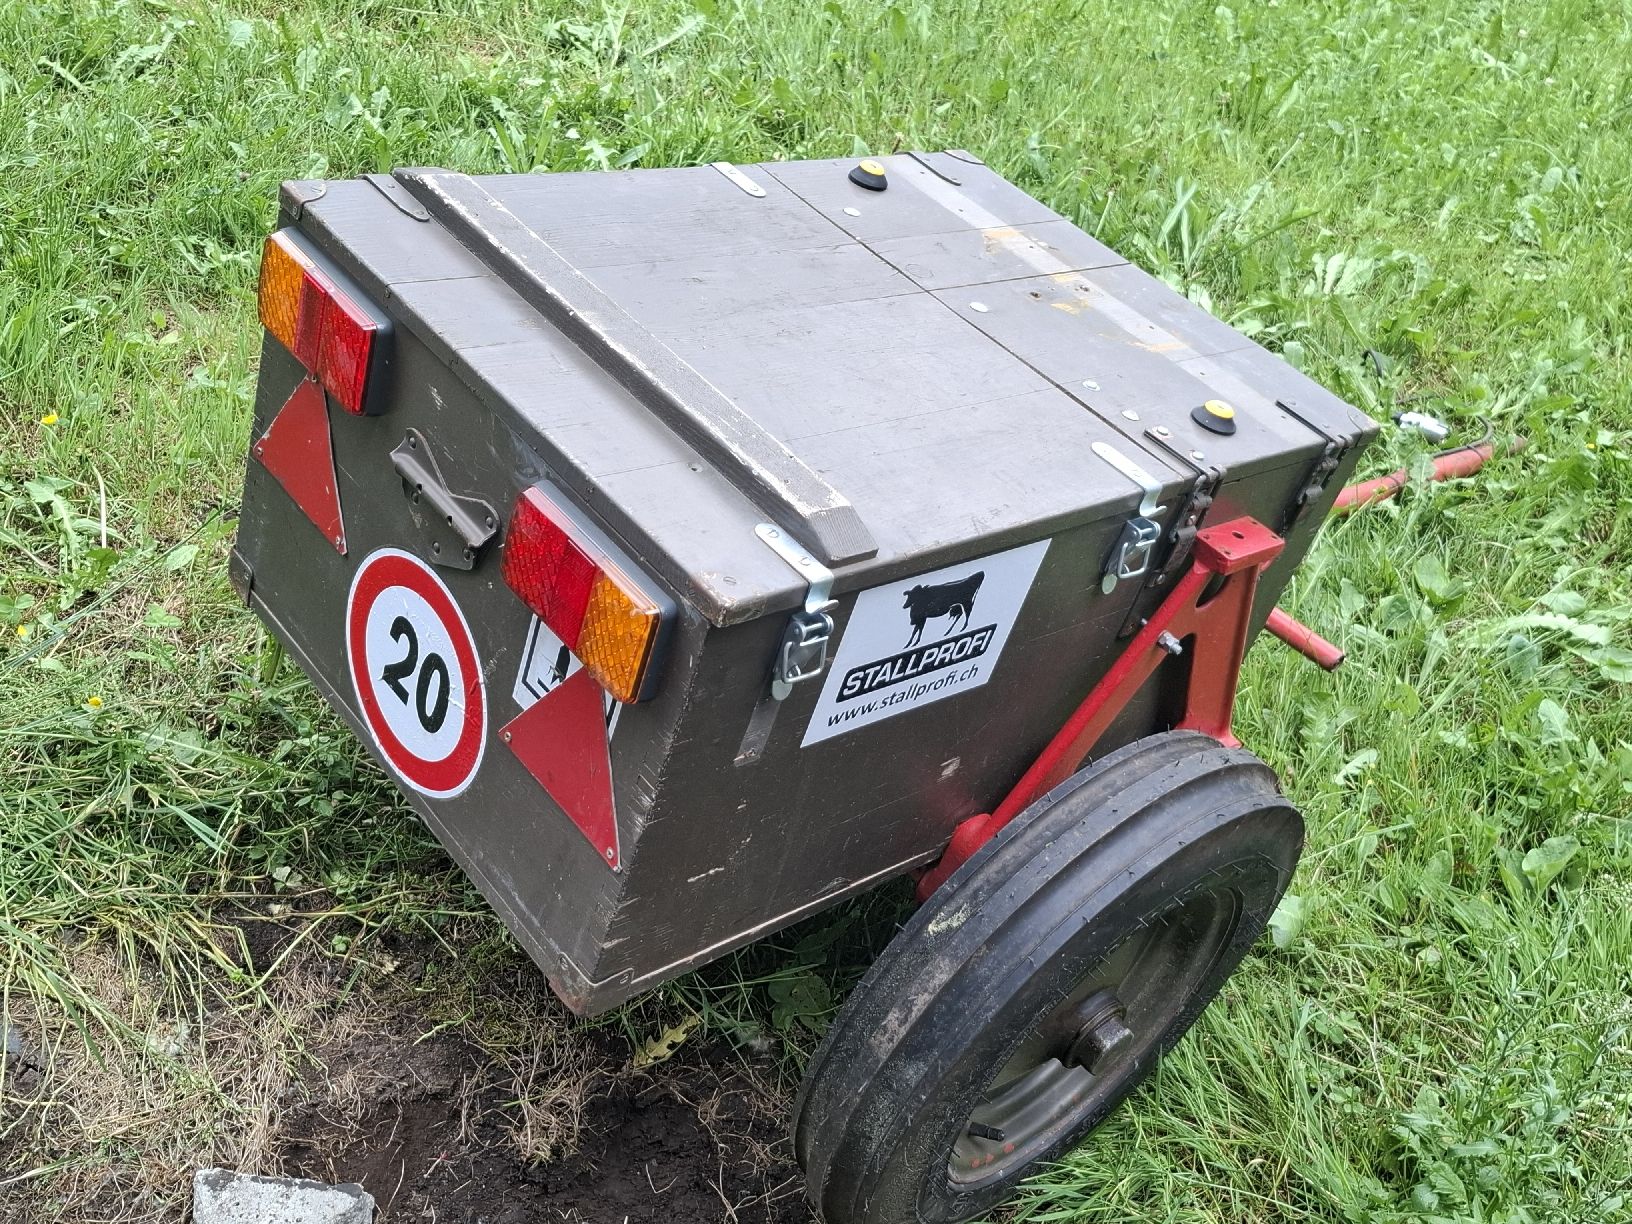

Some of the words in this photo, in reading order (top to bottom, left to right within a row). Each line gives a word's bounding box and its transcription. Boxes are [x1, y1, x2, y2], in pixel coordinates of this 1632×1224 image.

[379, 615, 451, 733] 20
[827, 664, 979, 727] www.stallprofi.ch
[842, 629, 993, 696] STALLPROFI
